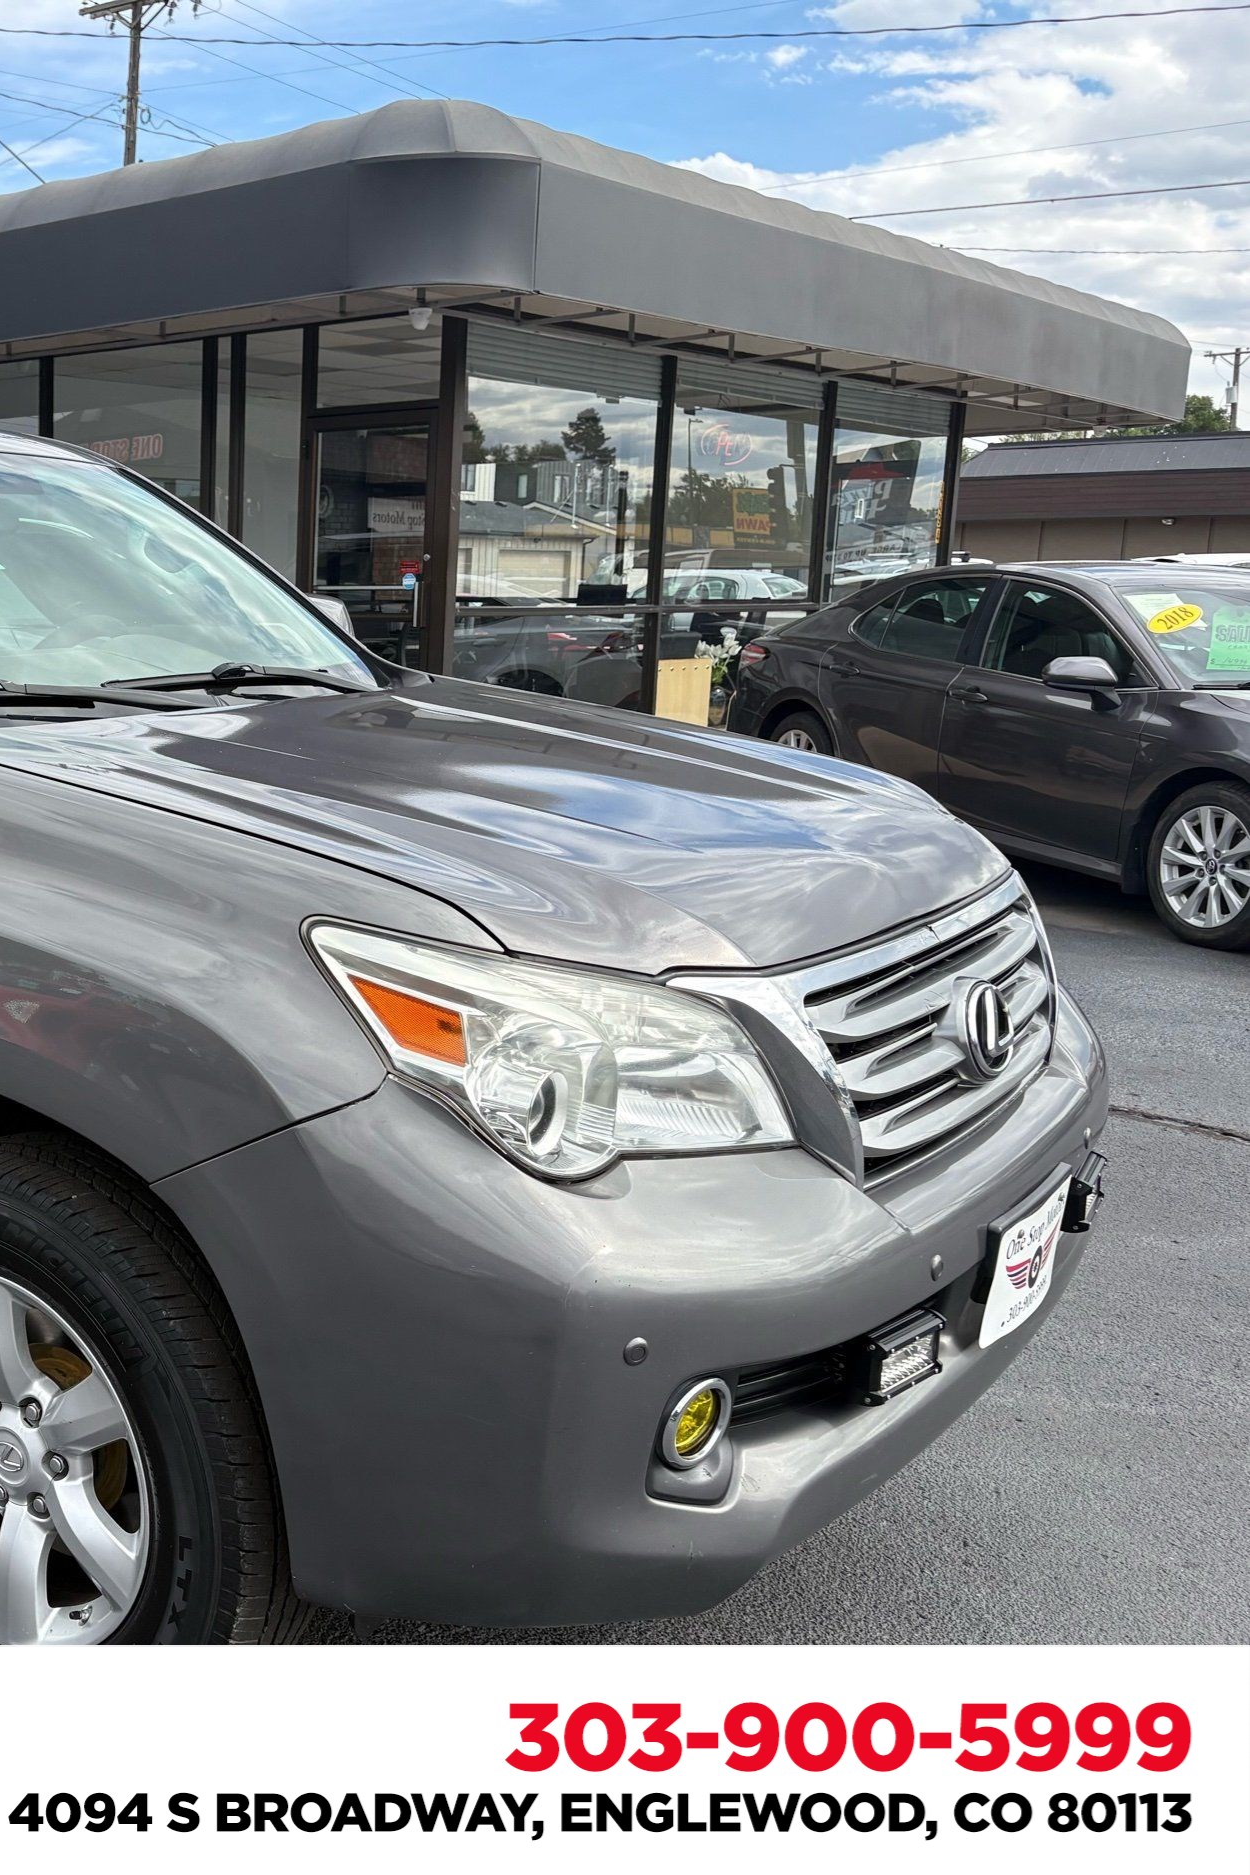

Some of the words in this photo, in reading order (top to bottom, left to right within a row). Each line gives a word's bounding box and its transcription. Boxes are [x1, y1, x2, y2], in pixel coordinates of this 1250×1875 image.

[1157, 606, 1194, 630] 2018
[1006, 1237, 1027, 1260] One
[1027, 1221, 1046, 1246] Stop
